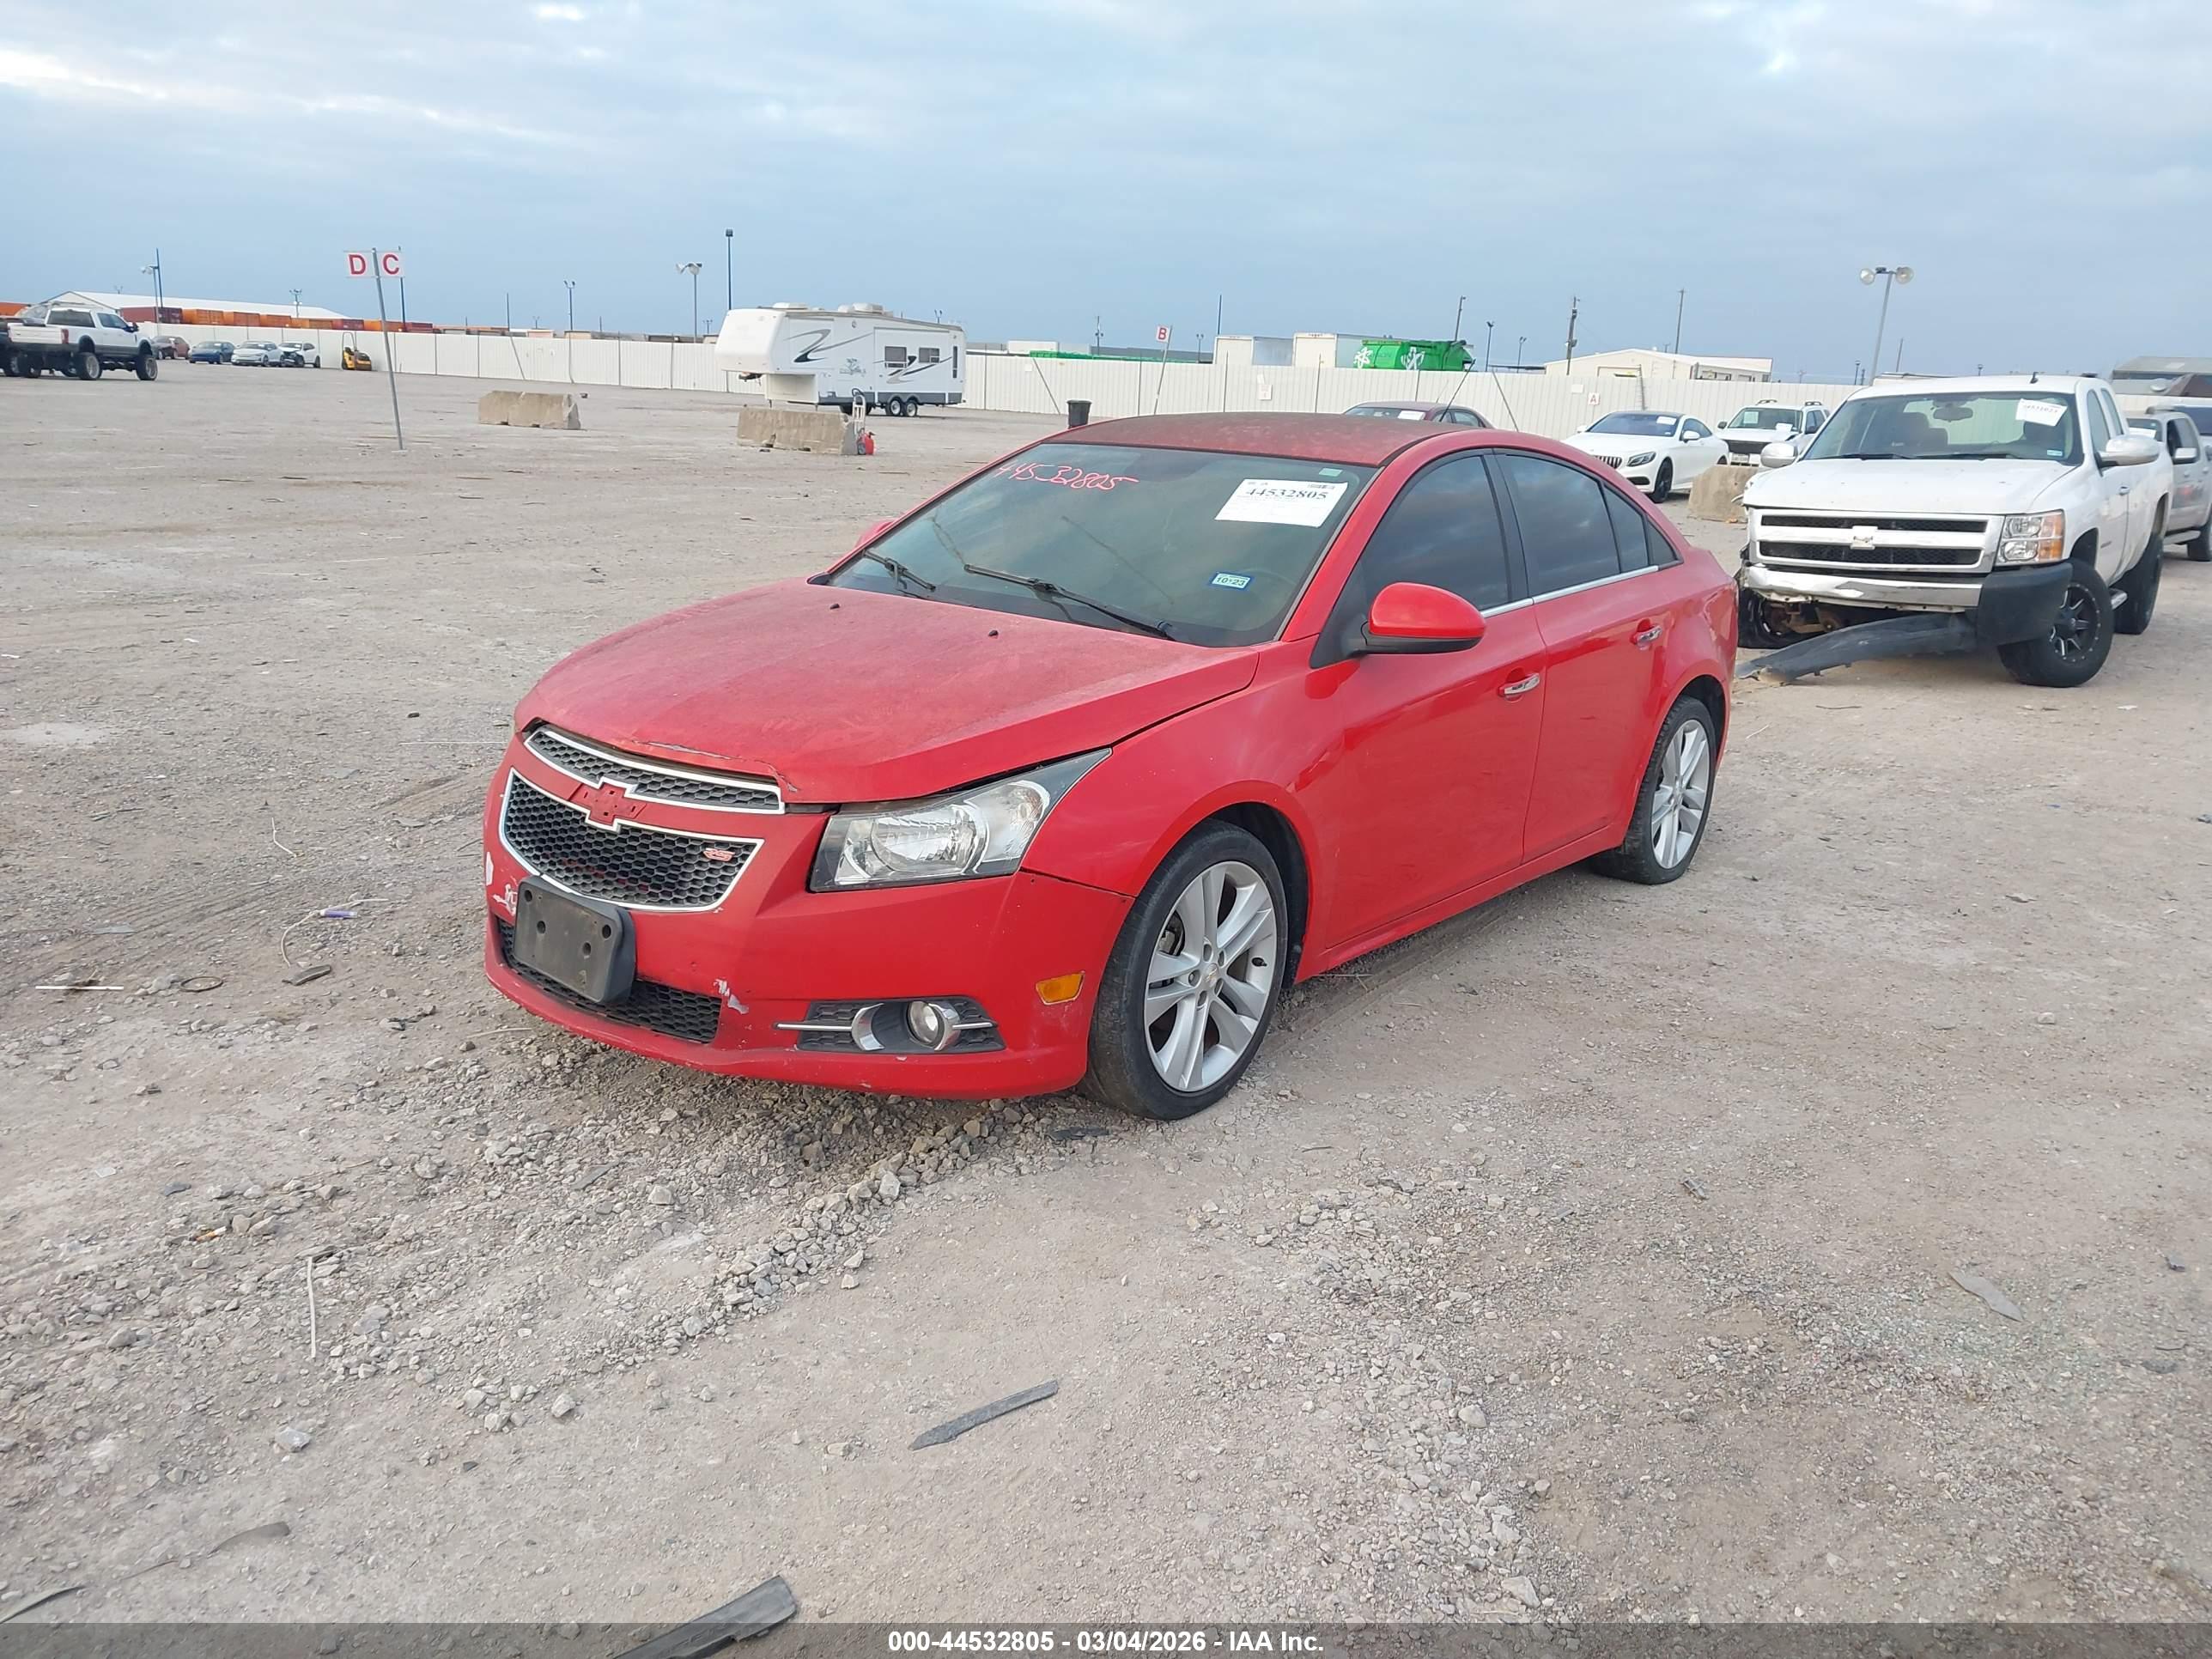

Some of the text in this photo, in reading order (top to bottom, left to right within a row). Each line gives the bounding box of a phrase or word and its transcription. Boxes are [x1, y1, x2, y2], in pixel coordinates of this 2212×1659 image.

[349, 253, 367, 275] D
[383, 253, 400, 275] C
[1158, 327, 1167, 340] B
[1589, 394, 1597, 404] A
[994, 459, 1139, 490] 44532805
[1246, 487, 1328, 500] 44532805
